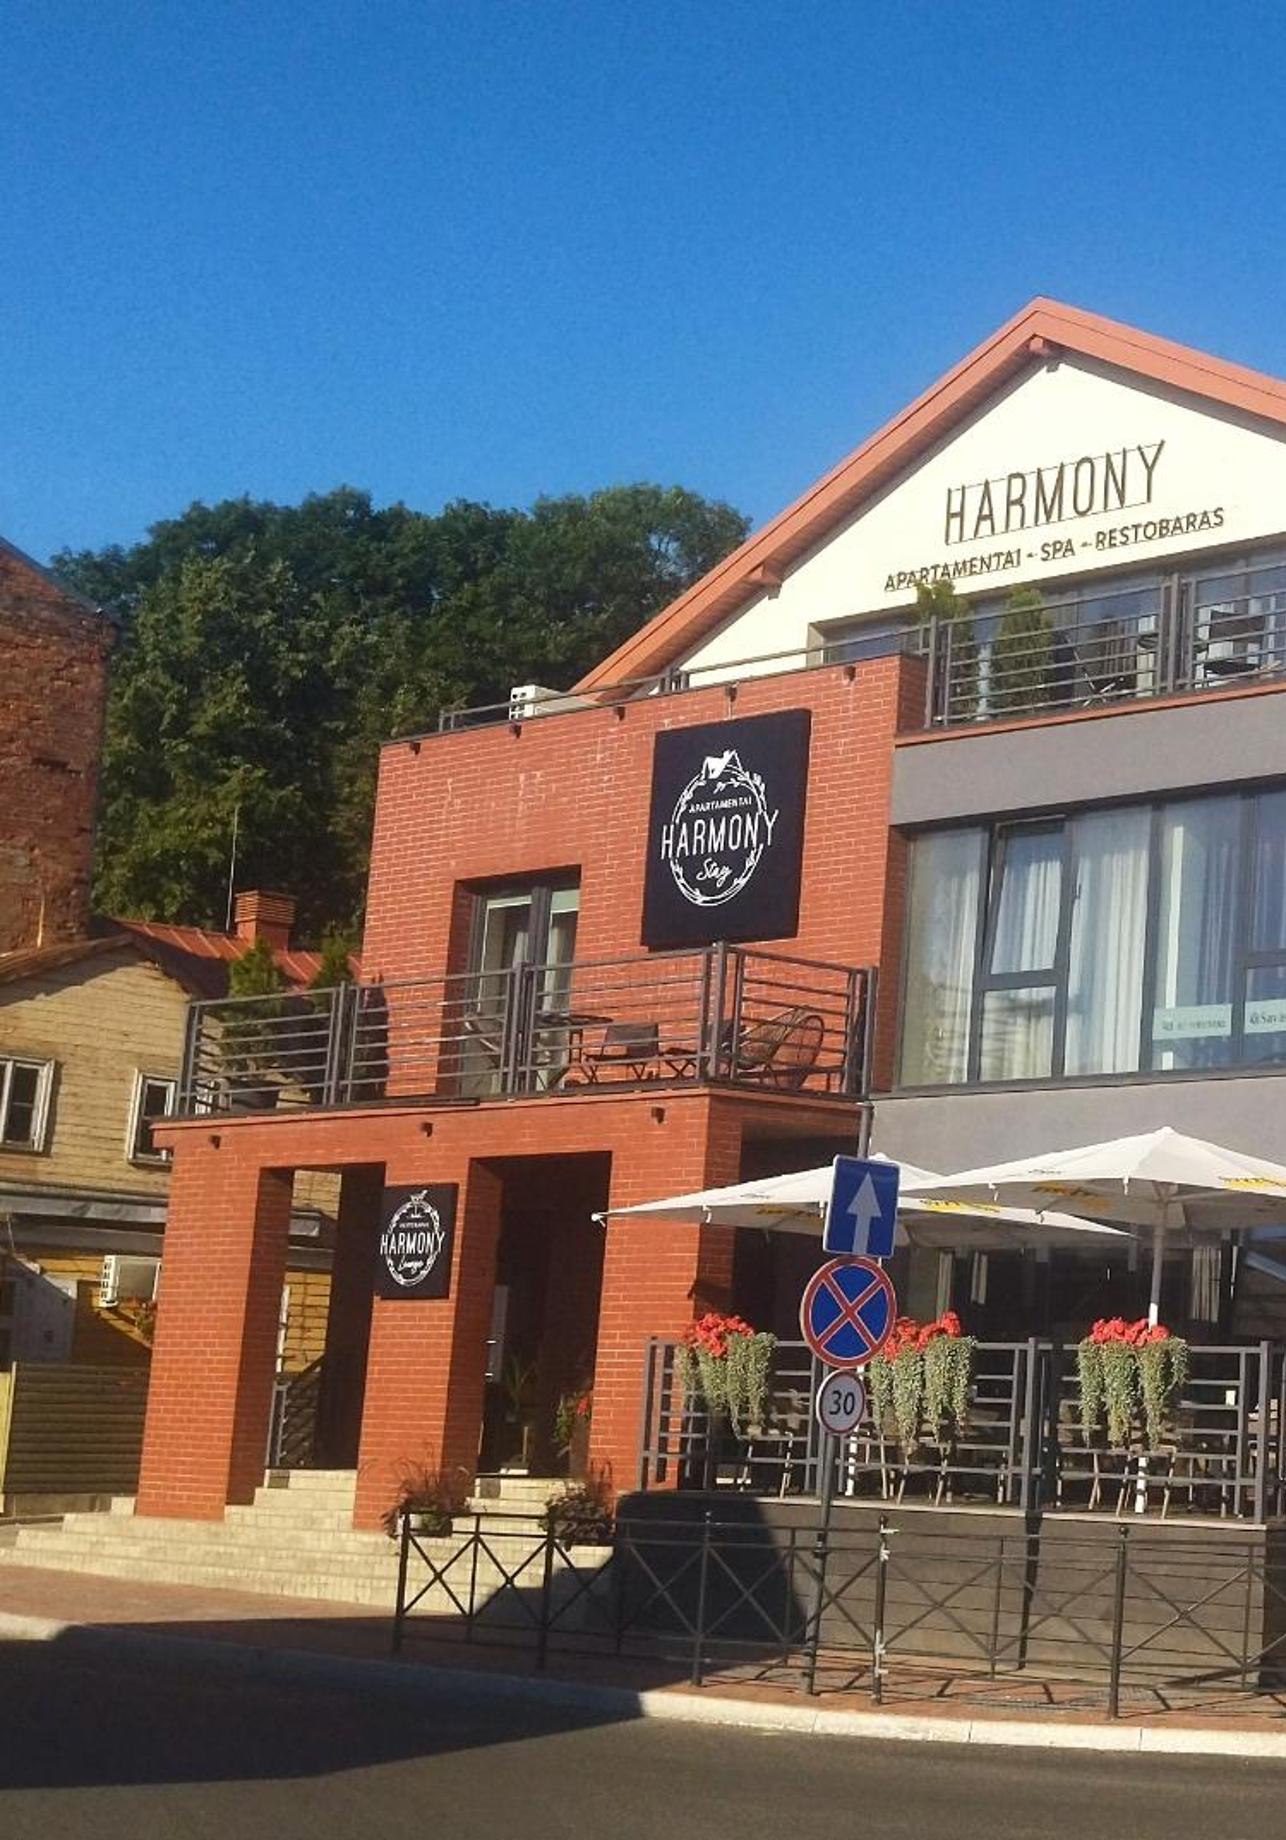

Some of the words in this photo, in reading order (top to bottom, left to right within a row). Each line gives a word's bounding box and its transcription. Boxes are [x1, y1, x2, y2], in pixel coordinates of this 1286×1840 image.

[945, 439, 1165, 546] HARMONY
[884, 549, 1021, 591] APARTAMENTAI
[1040, 538, 1076, 562] SPA
[1094, 507, 1225, 551] RESTOBARAS
[660, 809, 779, 860] HARMONY
[380, 1231, 445, 1256] HARMONY
[829, 1391, 855, 1416] 30
